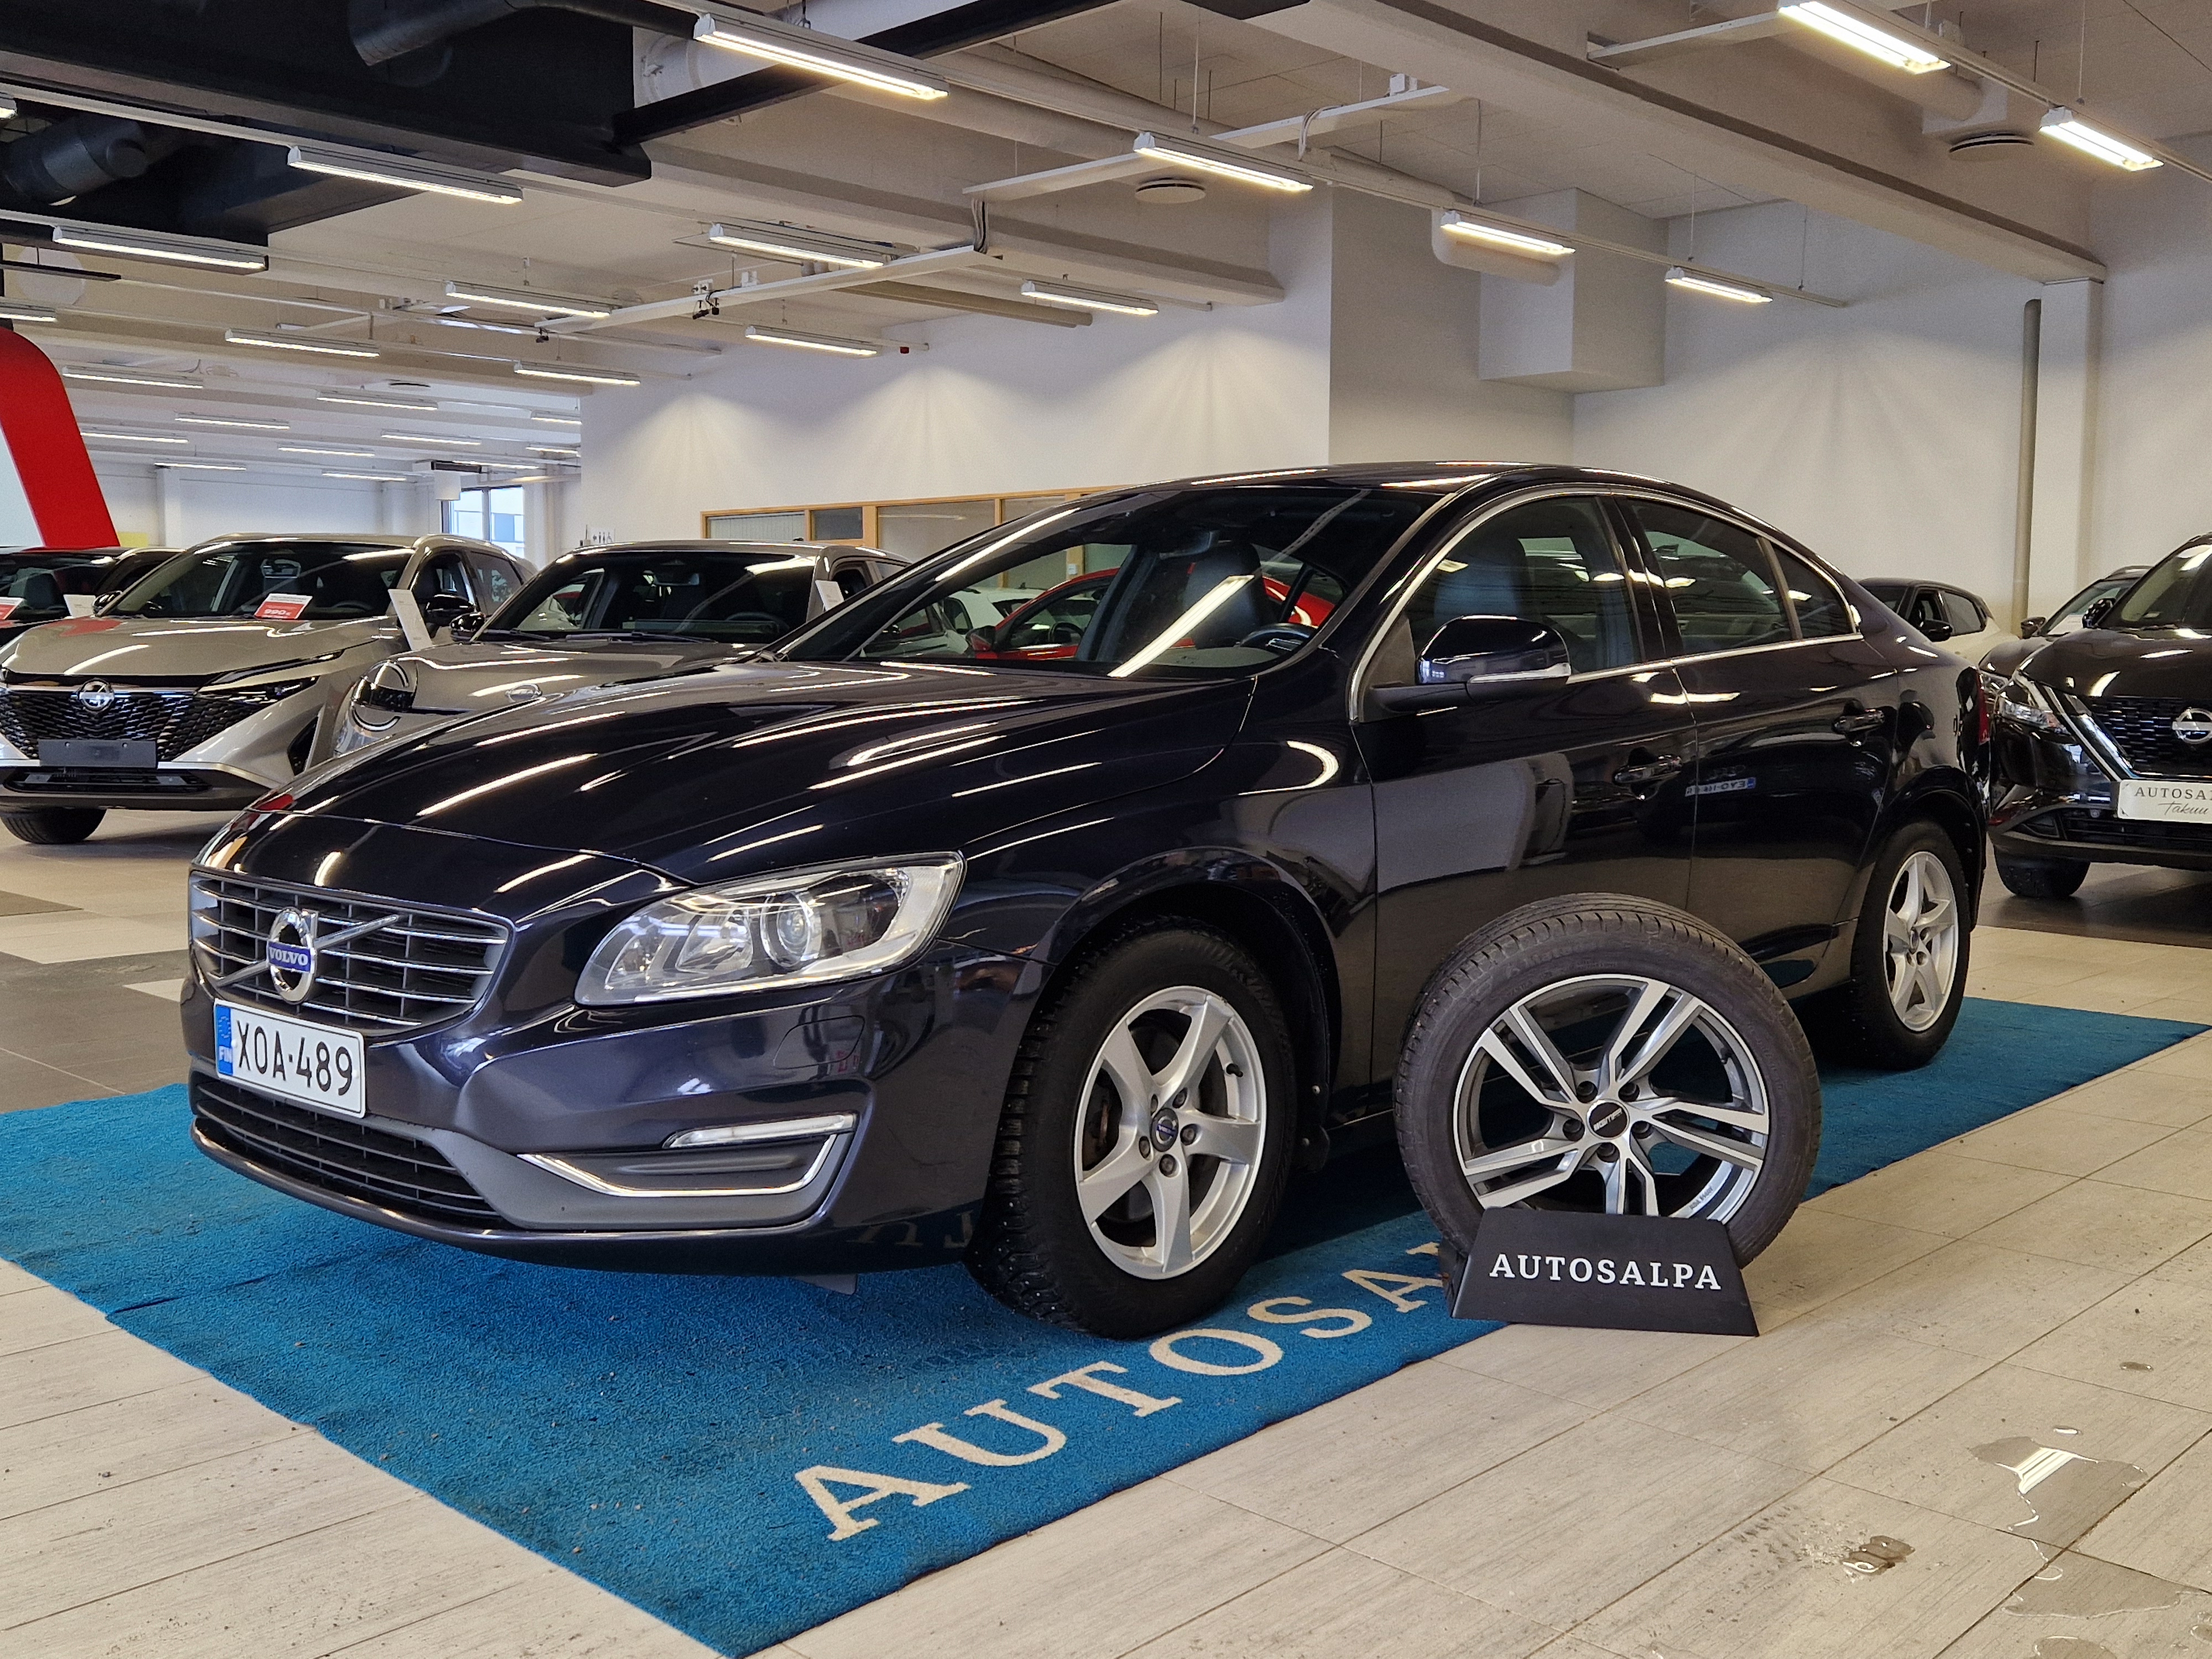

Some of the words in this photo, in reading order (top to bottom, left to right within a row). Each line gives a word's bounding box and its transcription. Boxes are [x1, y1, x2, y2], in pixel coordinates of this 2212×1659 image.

[2134, 786, 2212, 801] AUTOSA
[2158, 801, 2209, 816] Takuu
[268, 946, 309, 966] VOLVO
[237, 1020, 352, 1096] XOA-489
[1489, 1253, 1721, 1290] AUTOSALPA
[795, 1241, 1443, 1541] AUTOSA
